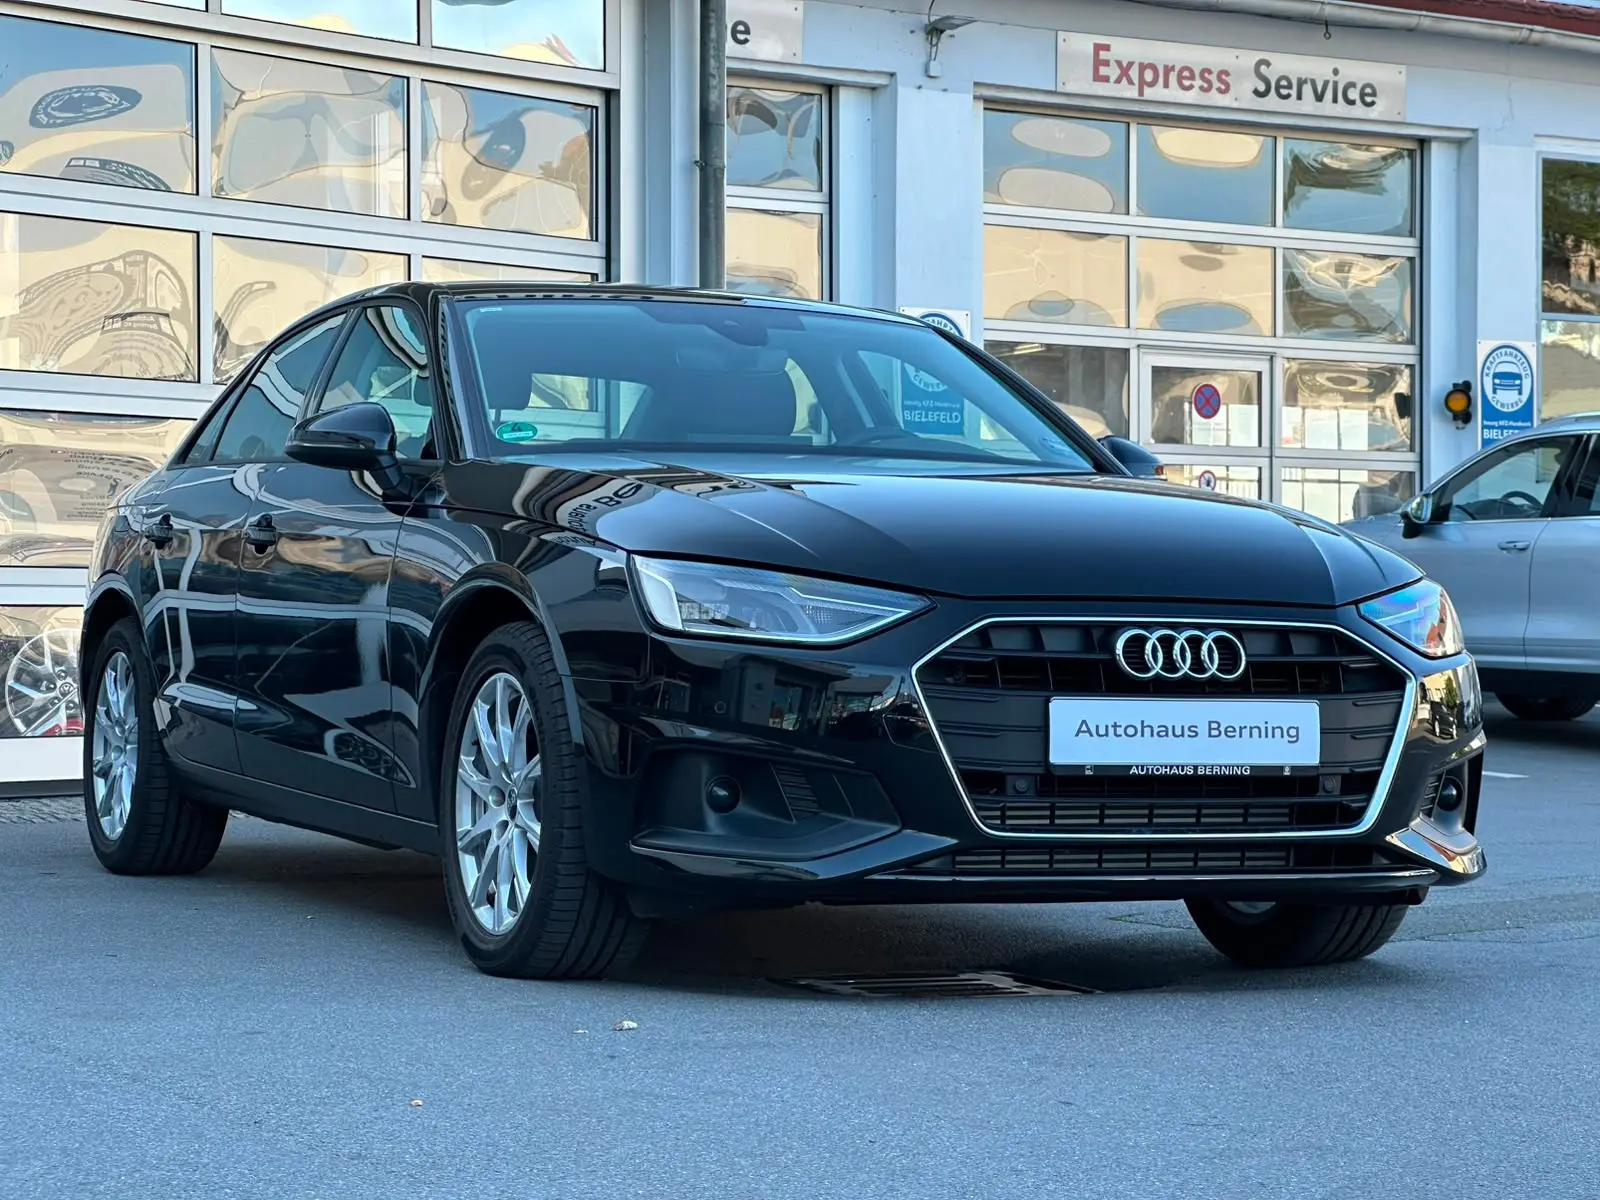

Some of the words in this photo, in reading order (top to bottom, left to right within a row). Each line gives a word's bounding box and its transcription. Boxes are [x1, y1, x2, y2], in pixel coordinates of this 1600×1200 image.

[1092, 42, 1232, 97] Express
[1252, 58, 1378, 107] Service
[903, 410, 961, 423] BIELEFELD
[1074, 719, 1199, 738] Autohaus
[1207, 720, 1300, 744] Berning
[1130, 765, 1194, 775] AUTOHAUS
[1197, 765, 1250, 775] BERNING
